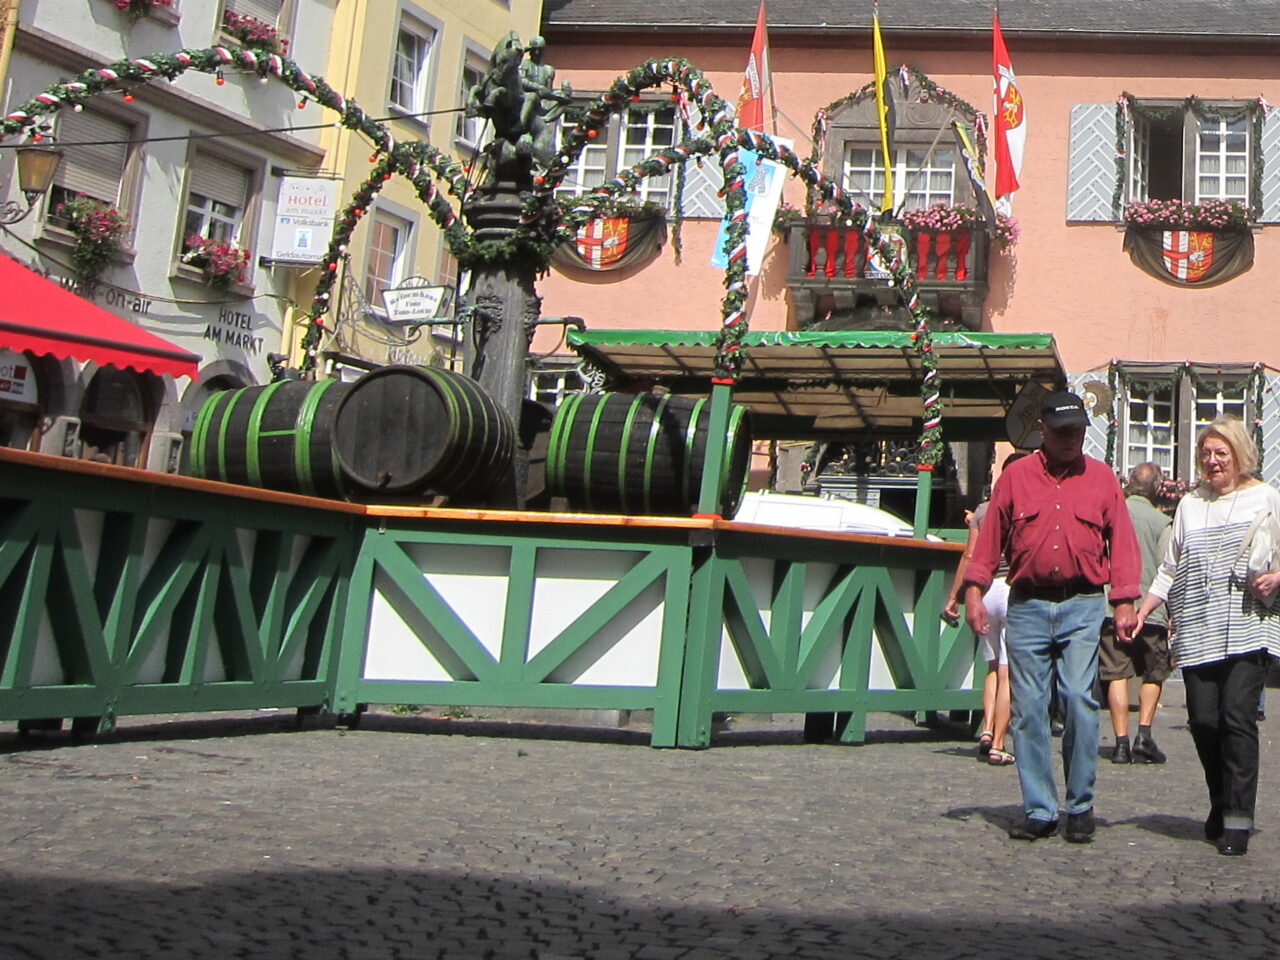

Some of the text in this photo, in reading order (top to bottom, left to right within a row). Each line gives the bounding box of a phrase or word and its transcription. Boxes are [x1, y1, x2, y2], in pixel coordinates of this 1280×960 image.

[293, 218, 329, 227] Volksbank
[218, 307, 252, 330] HOTEL
[203, 324, 264, 356] AM MARKT
